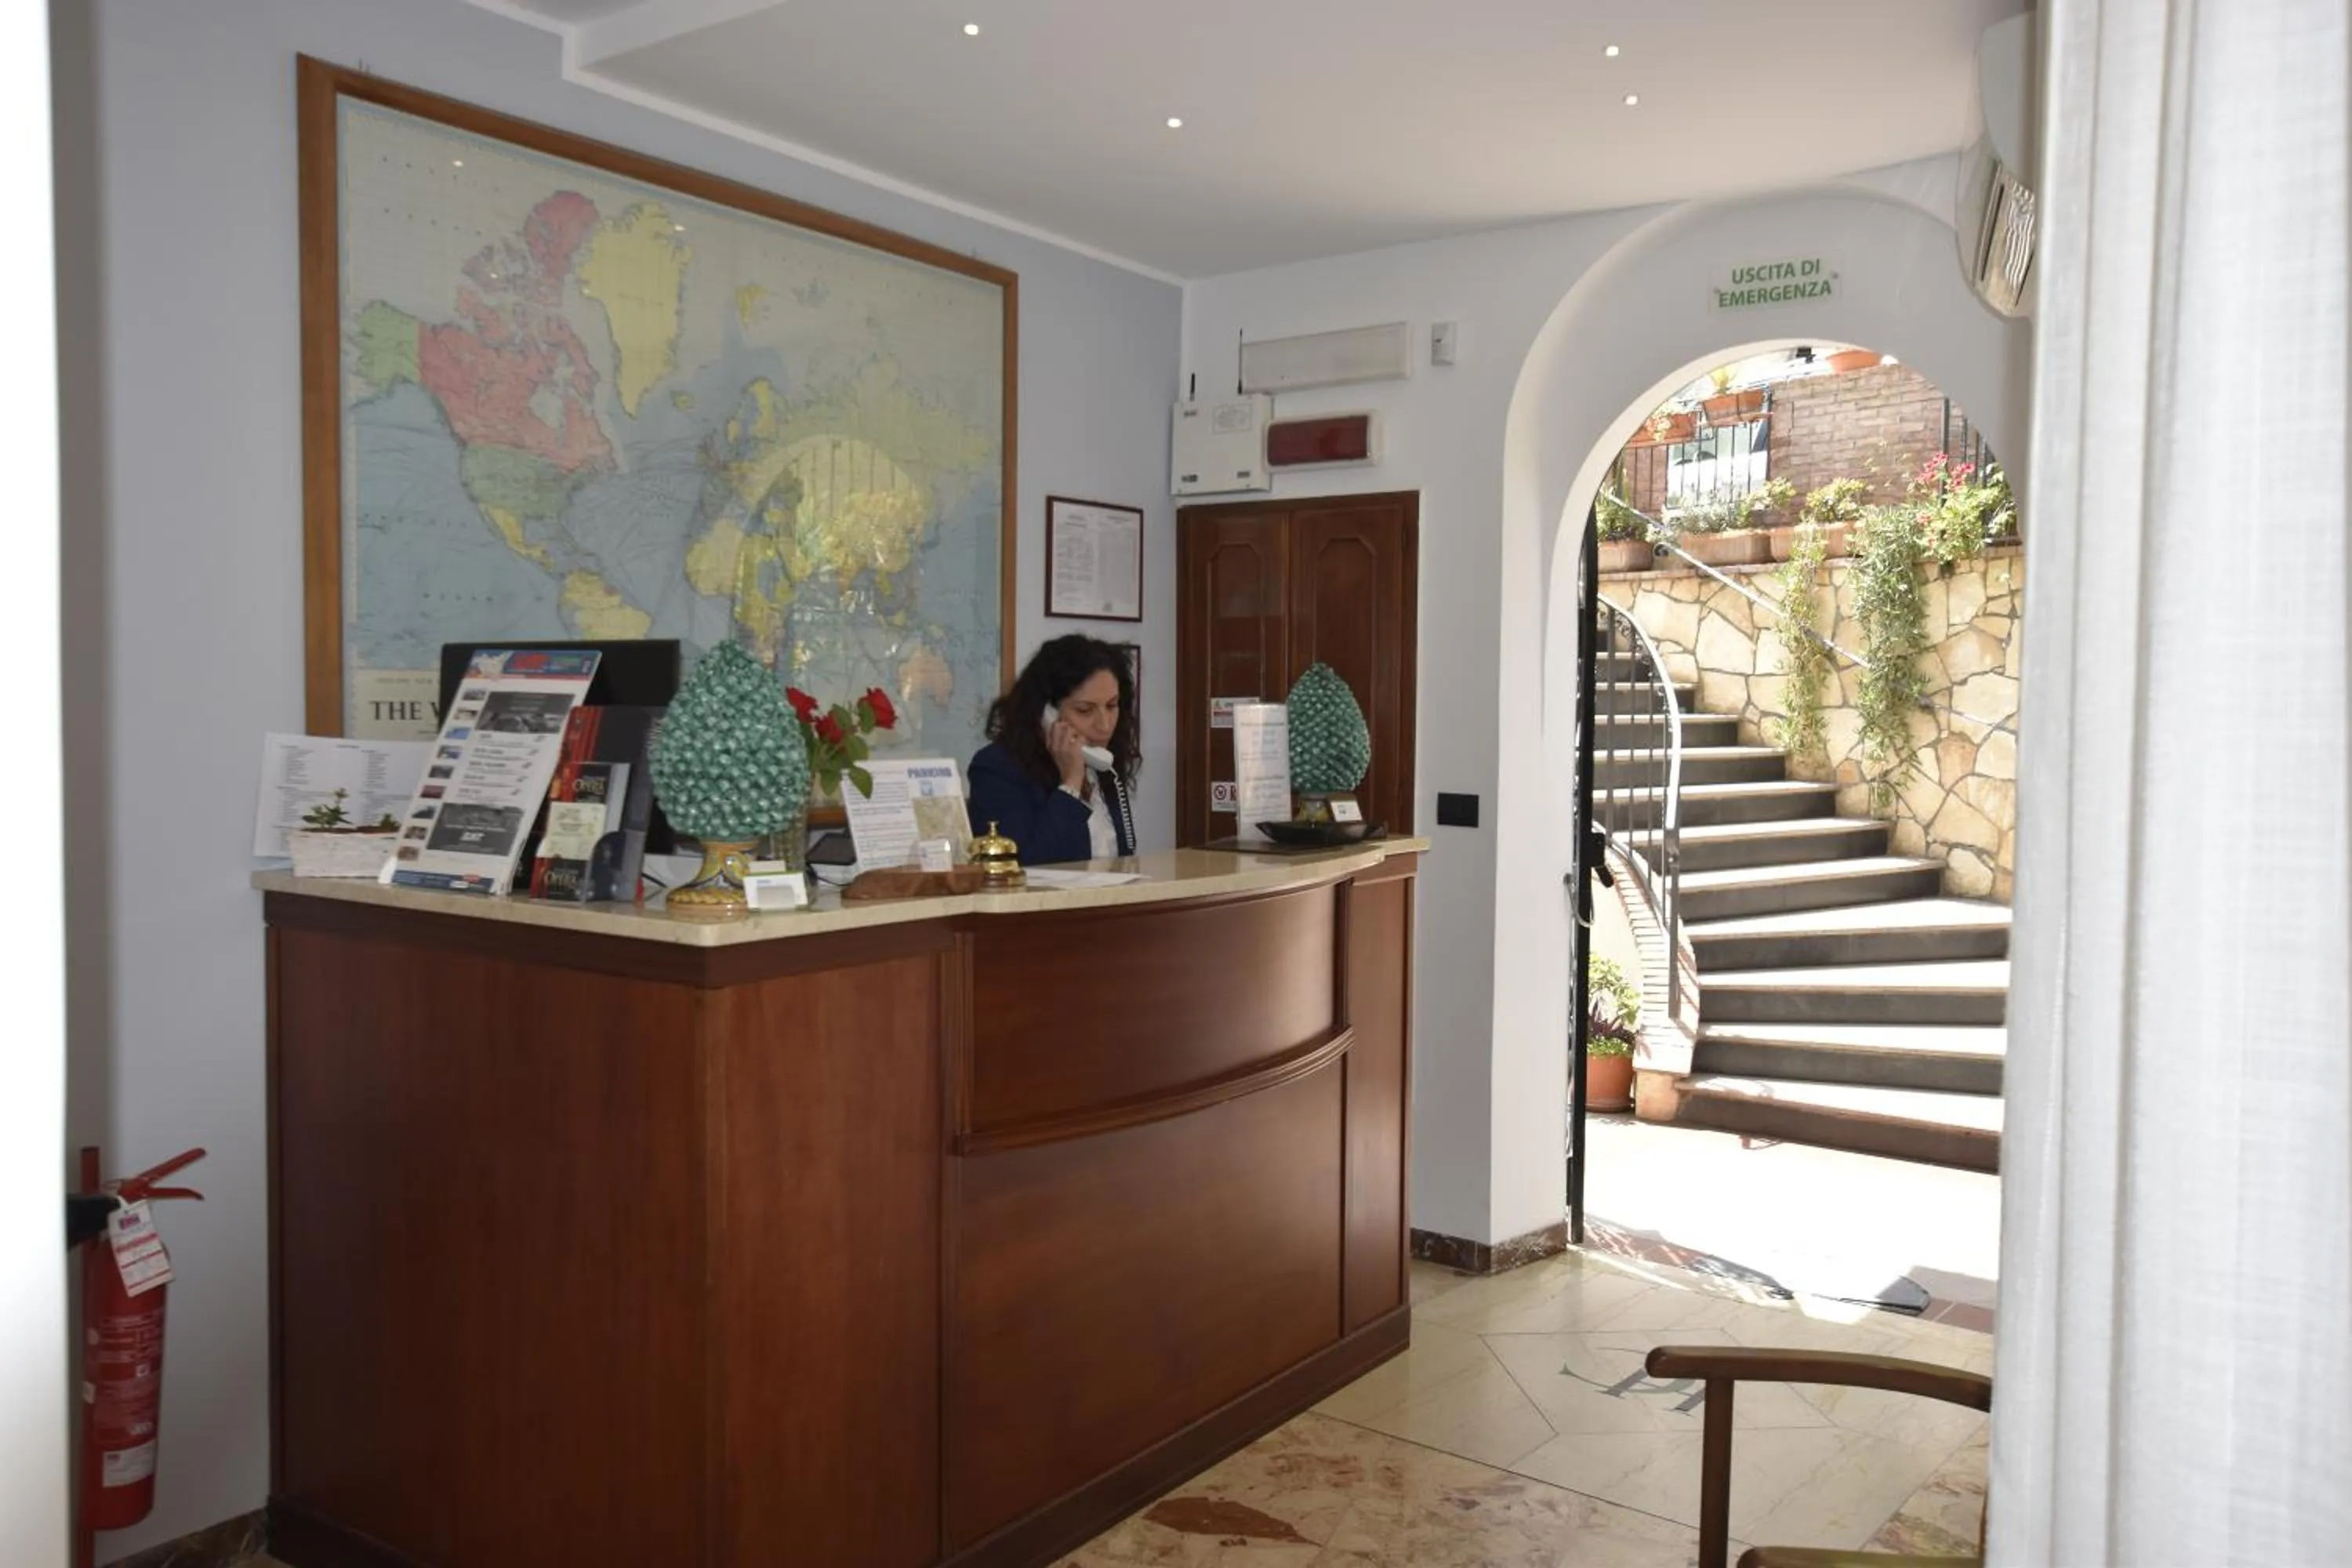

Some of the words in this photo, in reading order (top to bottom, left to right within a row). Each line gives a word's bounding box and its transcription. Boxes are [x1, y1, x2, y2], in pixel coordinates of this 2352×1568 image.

[1731, 263, 1796, 285] USCITA
[1801, 258, 1820, 276] DI
[1718, 279, 1832, 307] EMERGENZA
[368, 699, 423, 720] THE
